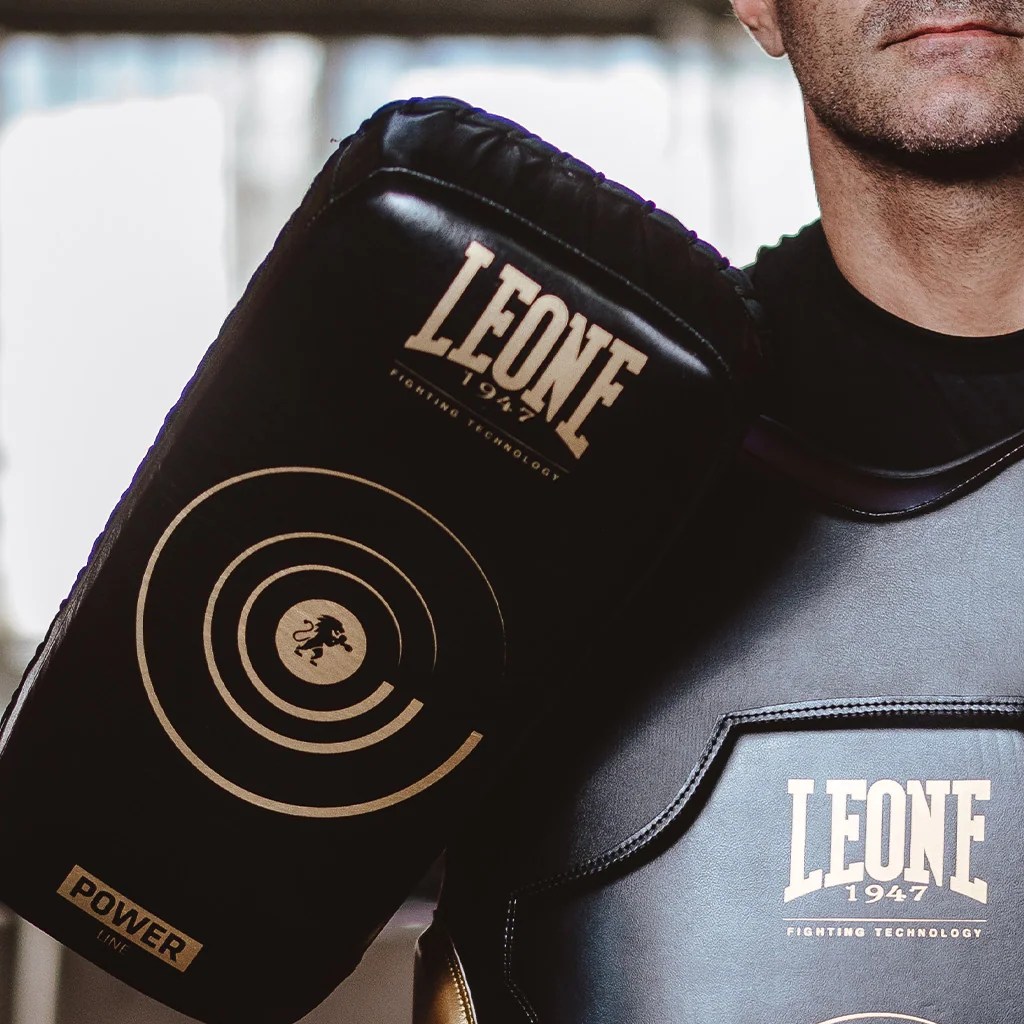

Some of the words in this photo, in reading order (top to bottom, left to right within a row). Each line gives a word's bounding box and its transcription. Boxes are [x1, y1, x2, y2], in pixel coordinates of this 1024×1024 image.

[404, 240, 649, 459] LEONE
[389, 368, 460, 418] FIGHTING
[467, 418, 560, 481] TECHNOLOGY
[460, 369, 537, 422] 1947
[783, 778, 991, 905] LEONE
[69, 875, 187, 962] POWER
[845, 884, 929, 903] 1947
[96, 929, 130, 955] LINE
[786, 926, 866, 938] FIGHTING
[874, 927, 982, 939] TECHNOLOGY
